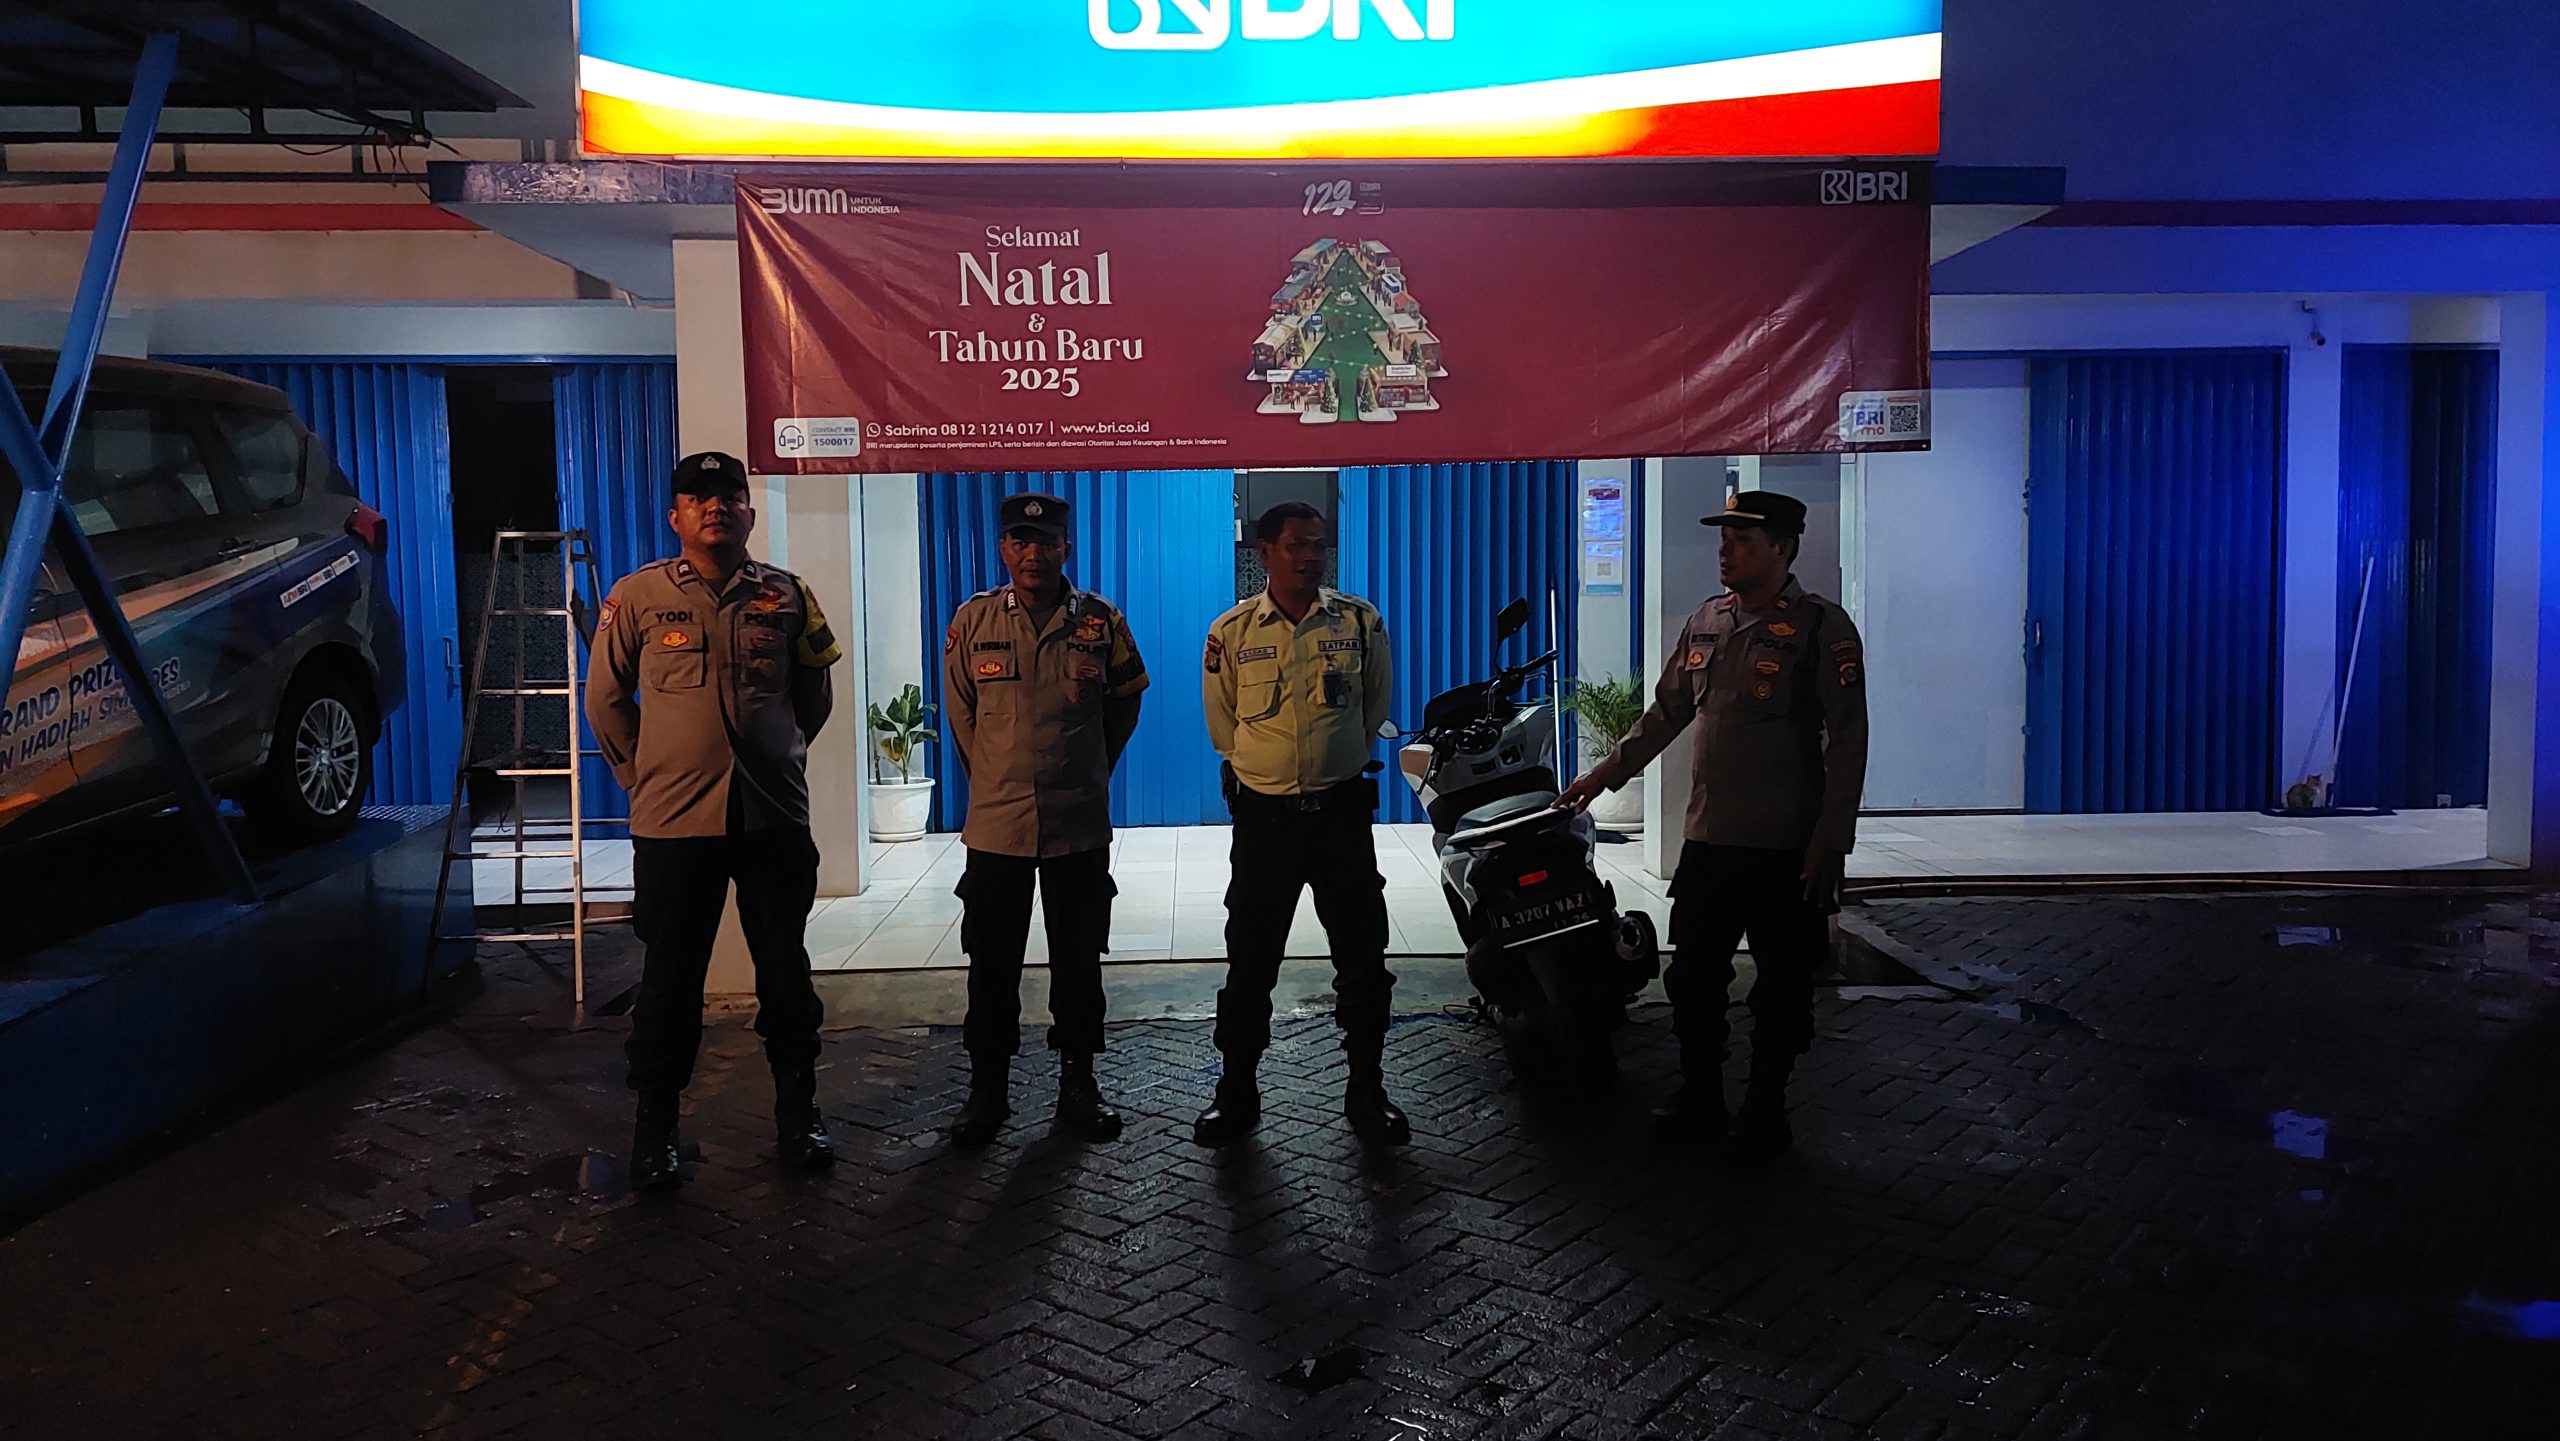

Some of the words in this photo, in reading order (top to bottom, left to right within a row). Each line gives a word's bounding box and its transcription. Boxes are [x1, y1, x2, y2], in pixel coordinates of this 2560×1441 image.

[1856, 171, 1908, 201] BRI
[850, 197, 882, 205] UNTUK
[851, 205, 900, 214] INDONESIA
[986, 225, 1081, 248] Selamat
[956, 251, 1113, 307] Natal
[1028, 312, 1046, 333] &
[928, 330, 1048, 363] Tahun
[1056, 329, 1144, 362] Baru
[1000, 366, 1081, 398] 2025
[1856, 411, 1884, 426] BRI
[885, 424, 938, 436] Sabrina
[941, 424, 976, 436] 0812
[981, 423, 1014, 436] 1214
[1017, 422, 1044, 435] 017
[1060, 421, 1150, 435] www.bri.co.id
[814, 438, 855, 446] 1500017
[879, 442, 919, 450] merupakan
[920, 441, 946, 450] peserta
[947, 440, 988, 450] penjaminan
[1087, 439, 1115, 447] Otoritas
[1115, 439, 1131, 447] Jasa
[1132, 439, 1168, 448] Keuangan
[1176, 438, 1194, 446] Bank
[1194, 438, 1228, 446] Indonesia
[656, 611, 693, 624] YODI
[21, 704, 93, 762] HADIAH
[1501, 915, 1511, 929] A
